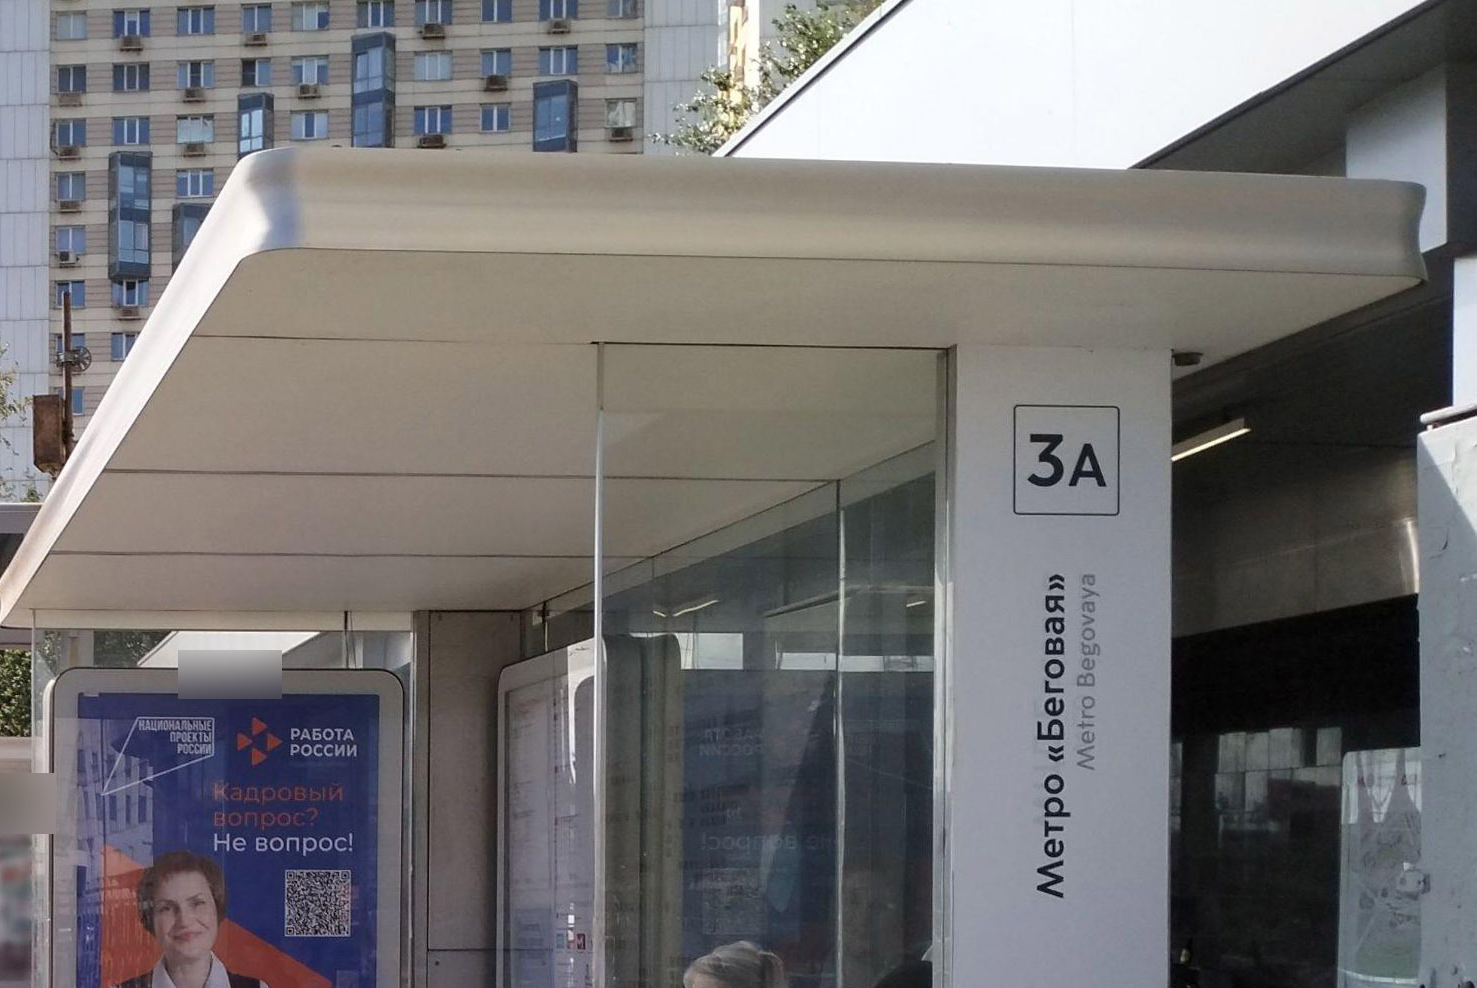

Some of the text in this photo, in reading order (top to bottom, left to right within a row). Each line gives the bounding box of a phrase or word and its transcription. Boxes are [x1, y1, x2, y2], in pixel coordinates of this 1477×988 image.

[1076, 573, 1101, 771] Metro Begovaya
[138, 719, 212, 732] НАЦИОНАЛЬНЫЕ
[169, 731, 212, 743] ПРОЕКТЫ
[290, 728, 354, 741] РАБОТА
[1036, 573, 1071, 899] Метро «Беговая»
[177, 743, 212, 754] РОССИИ
[290, 744, 358, 757] РОССИИ
[213, 782, 344, 804] Кадровый
[213, 808, 319, 830] вопрос?
[213, 833, 354, 856] Не вопрос!
